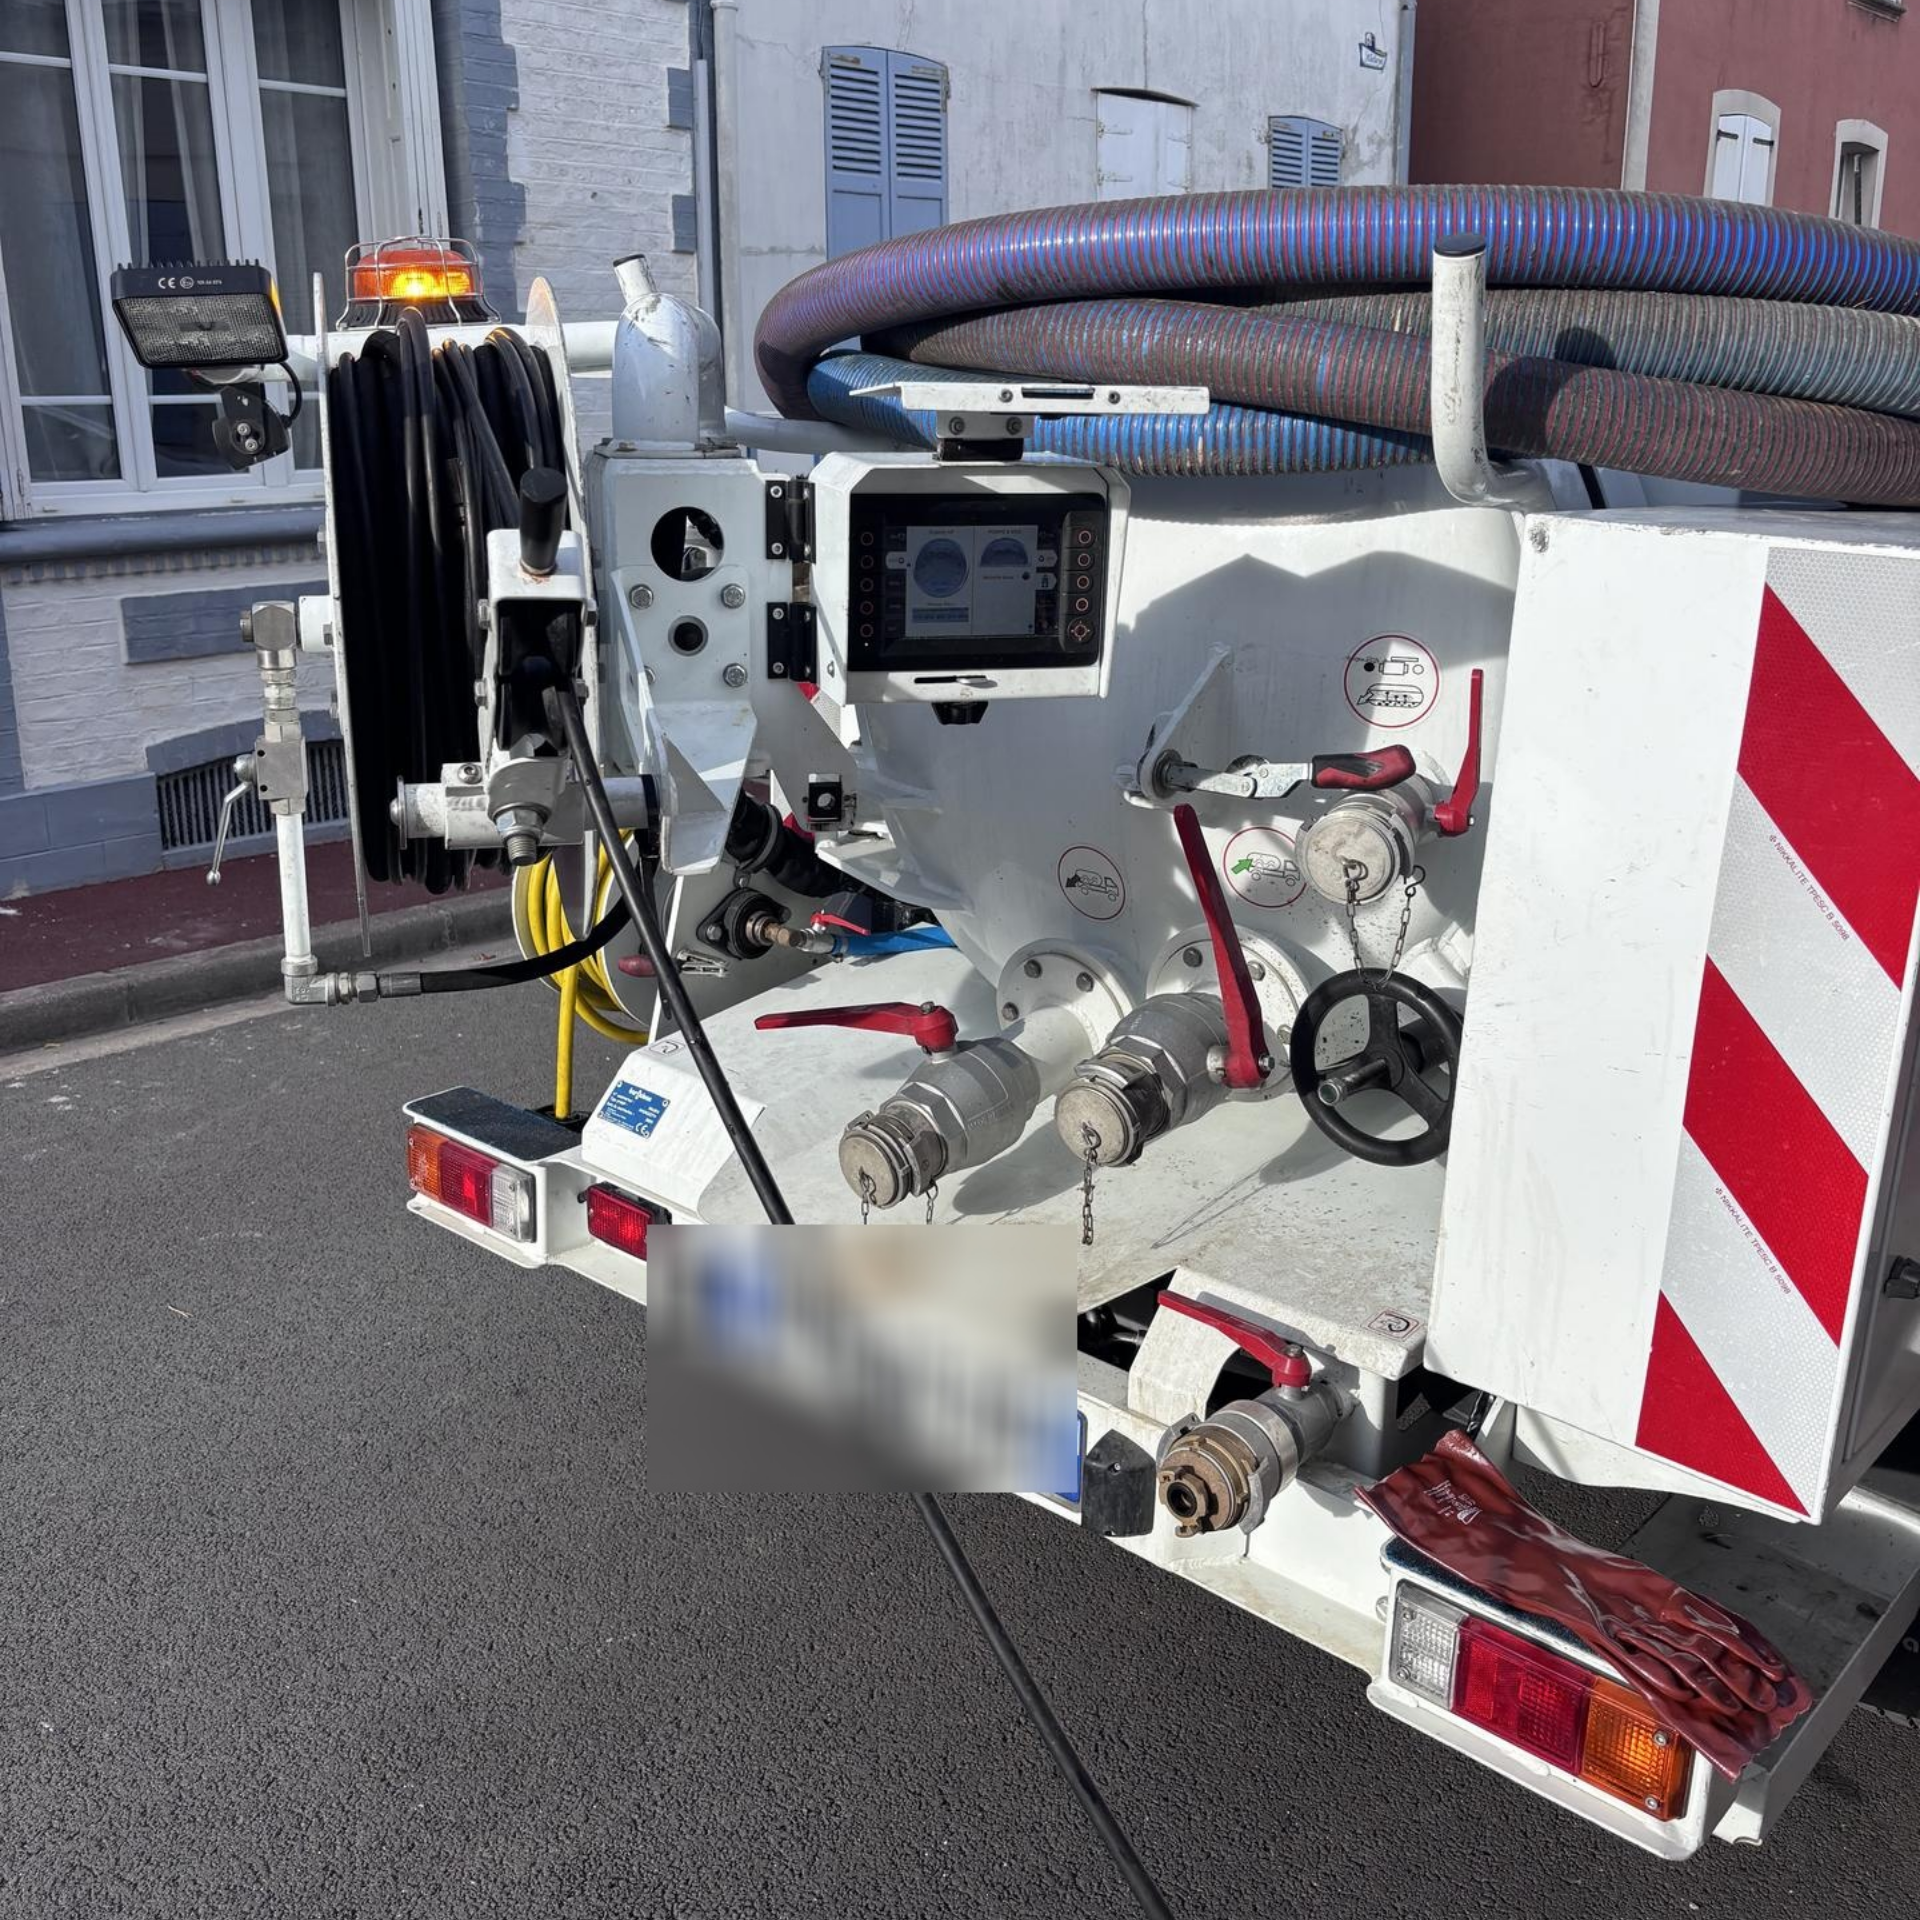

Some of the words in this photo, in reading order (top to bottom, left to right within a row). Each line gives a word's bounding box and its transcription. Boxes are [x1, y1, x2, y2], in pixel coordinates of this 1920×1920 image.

[158, 277, 176, 290] CE
[1774, 842, 1809, 886] NIKKALITE
[1806, 885, 1830, 914] TPESC
[1825, 911, 1835, 920] B
[1720, 1195, 1753, 1238] NIKKALITE
